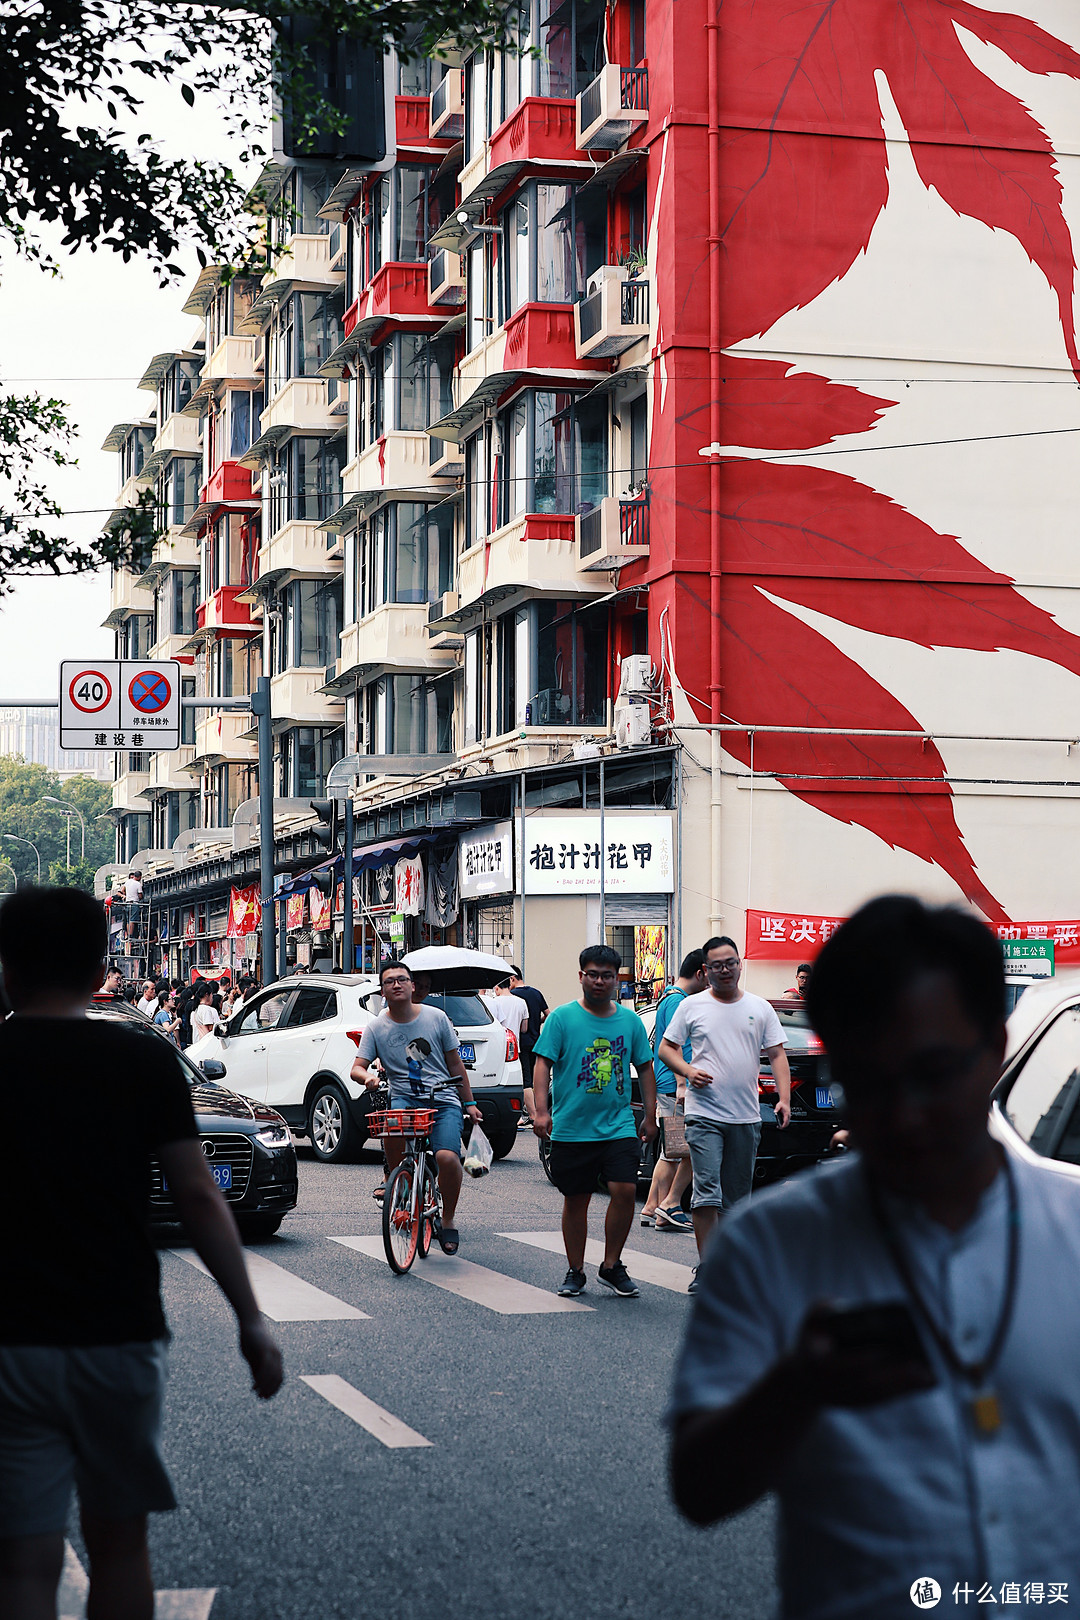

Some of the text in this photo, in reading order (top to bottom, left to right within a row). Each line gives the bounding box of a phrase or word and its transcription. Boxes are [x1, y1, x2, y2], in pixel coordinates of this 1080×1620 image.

[78, 682, 103, 701] 40
[133, 717, 169, 726] 停车场除外
[94, 733, 145, 746] 建设巷
[530, 843, 652, 870] 抱汁汁花甲
[1013, 946, 1047, 957] 施工公告
[213, 1168, 230, 1185] 89
